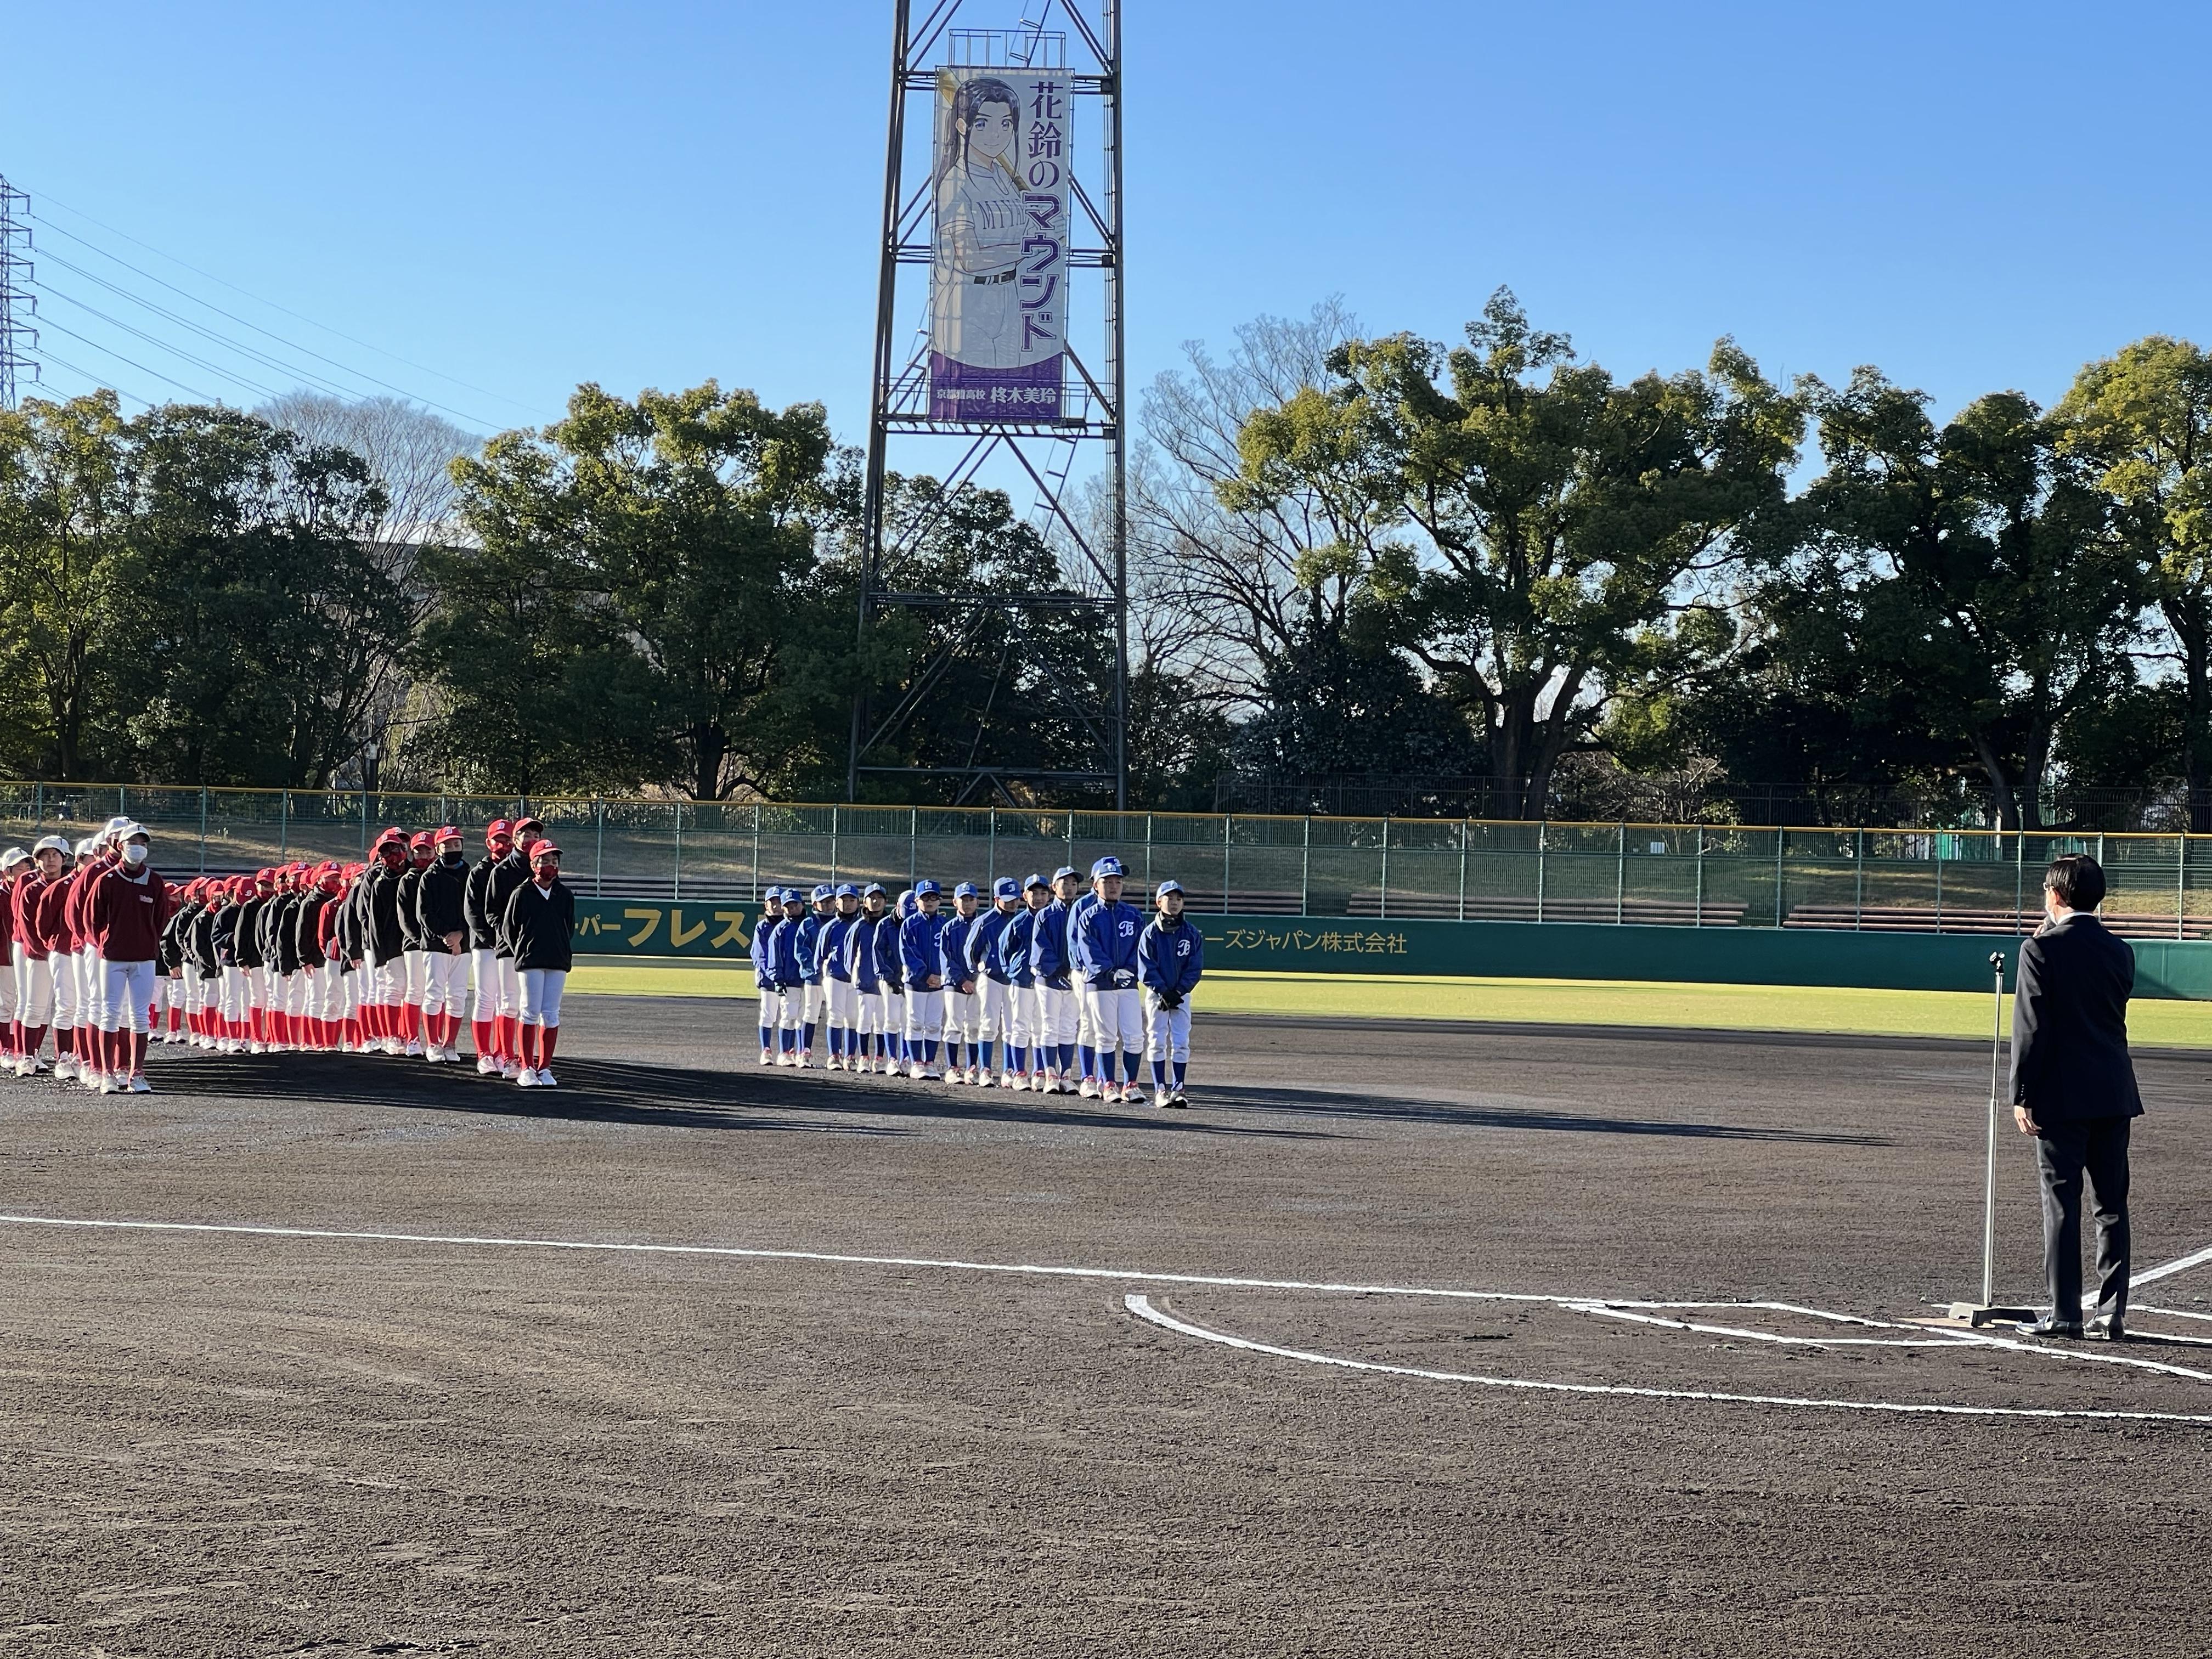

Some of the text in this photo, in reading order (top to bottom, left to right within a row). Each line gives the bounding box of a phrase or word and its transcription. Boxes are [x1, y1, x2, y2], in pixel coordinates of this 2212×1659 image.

[1019, 81, 1064, 352] 花鈴のマウンド
[990, 386, 1057, 404] 柊木美玲
[1199, 928, 1408, 954] ーズジャパン株式会社
